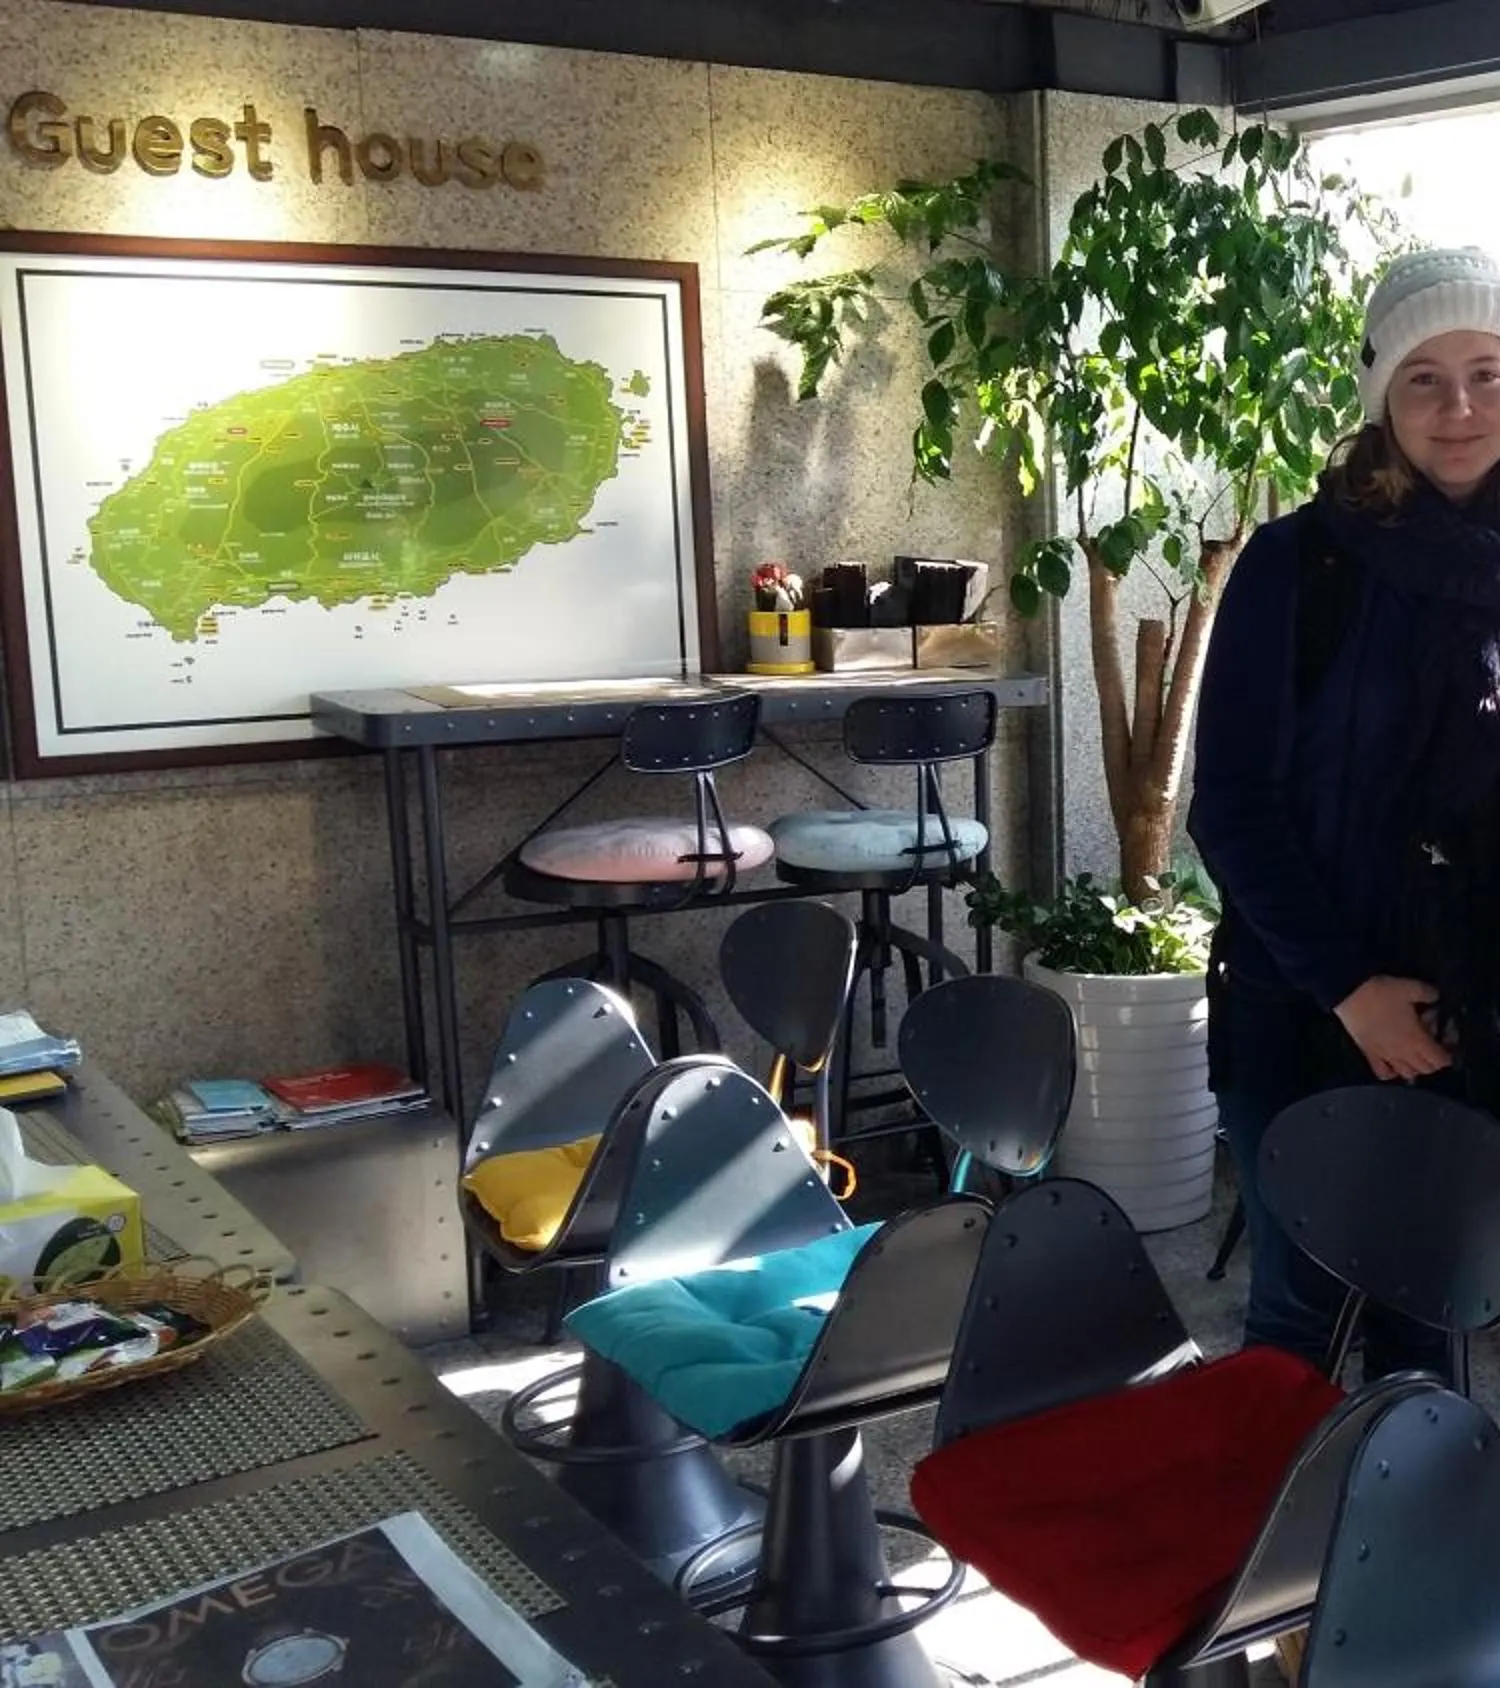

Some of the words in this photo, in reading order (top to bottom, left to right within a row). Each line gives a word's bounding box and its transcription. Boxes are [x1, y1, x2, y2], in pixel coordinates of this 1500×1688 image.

[8, 90, 274, 182] Guest
[304, 105, 546, 192] house
[102, 1541, 388, 1651] OMEGA
